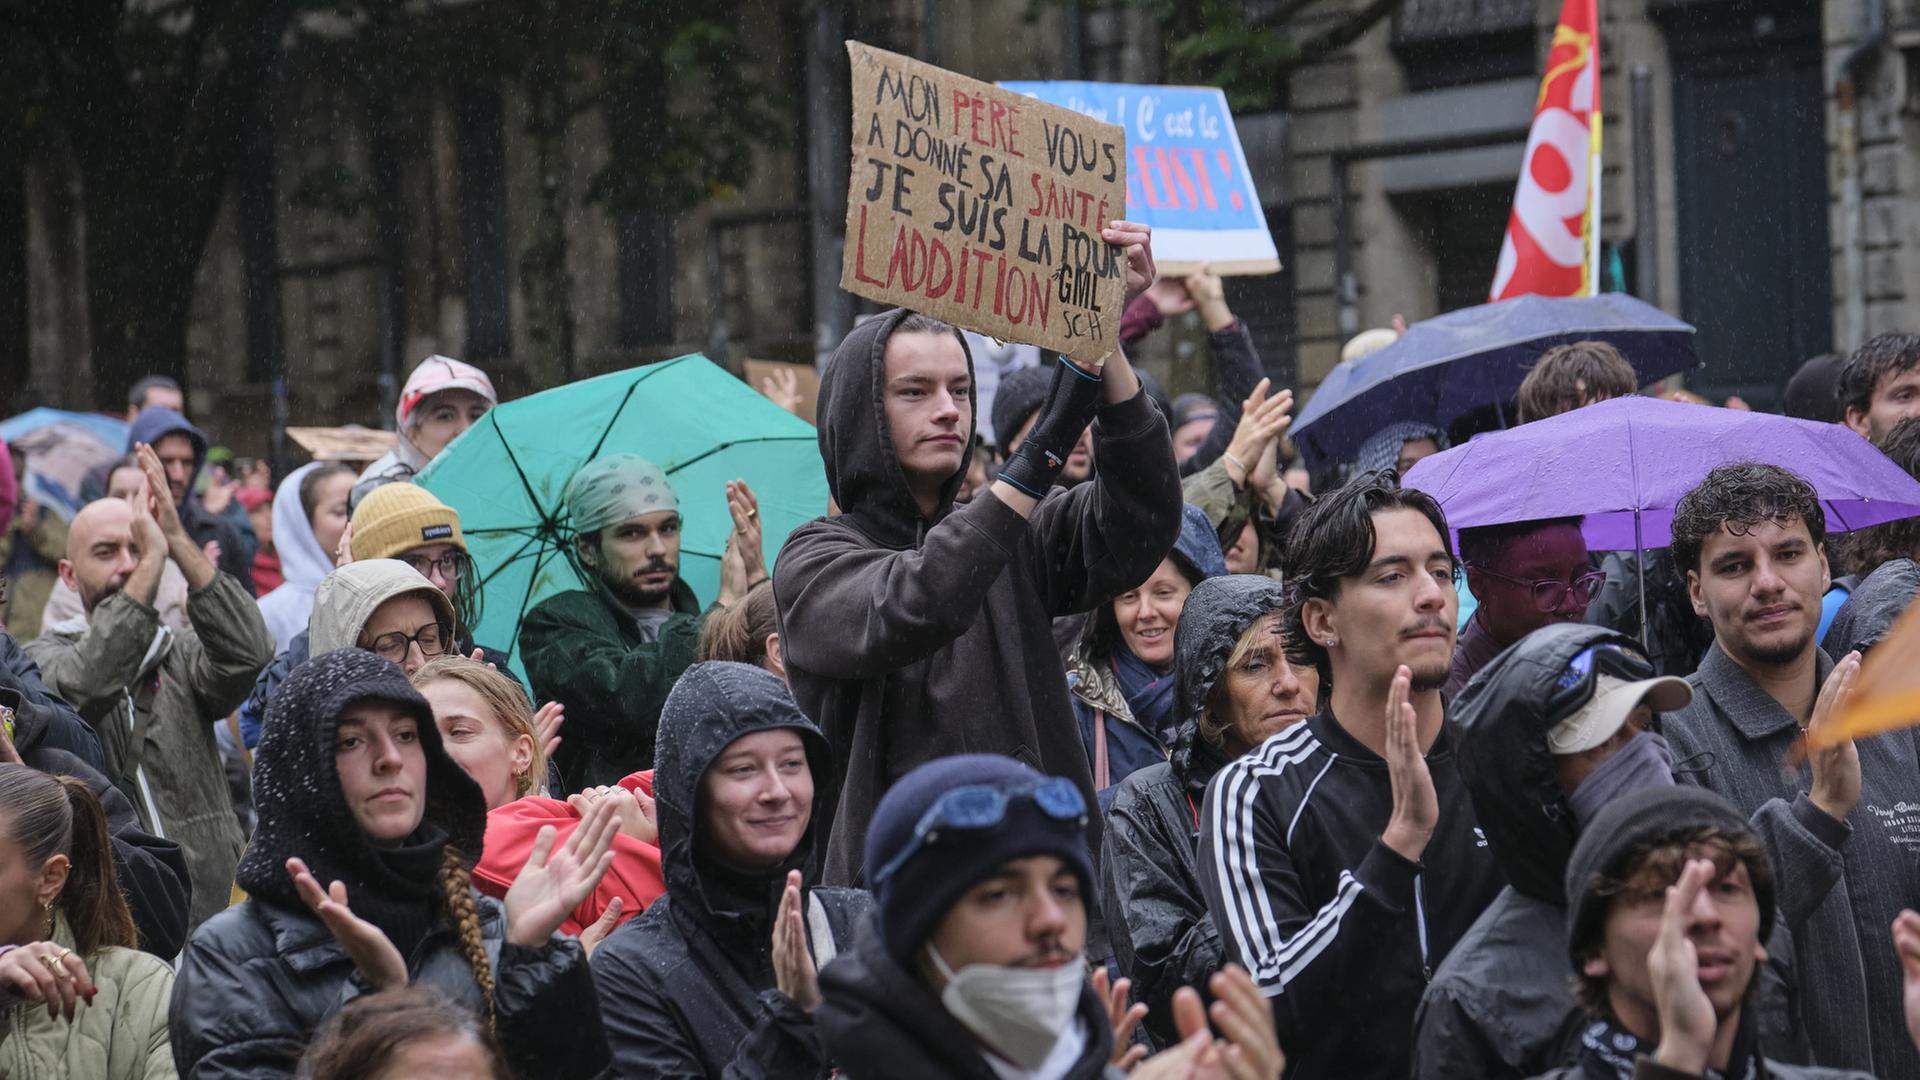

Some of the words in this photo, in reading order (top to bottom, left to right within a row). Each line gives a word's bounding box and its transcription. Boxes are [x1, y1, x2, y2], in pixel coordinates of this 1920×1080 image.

[868, 112, 885, 148] A
[894, 119, 973, 188] DONNÉ
[979, 155, 1013, 207] SA
[1029, 173, 1109, 234] SANTÉ
[876, 66, 940, 129] MON
[1043, 118, 1117, 183] VOUS
[866, 158, 915, 216] JE
[933, 183, 1008, 251] SUIS
[1018, 217, 1052, 266] LA
[1061, 223, 1122, 279] POUR
[1058, 263, 1101, 312] GML
